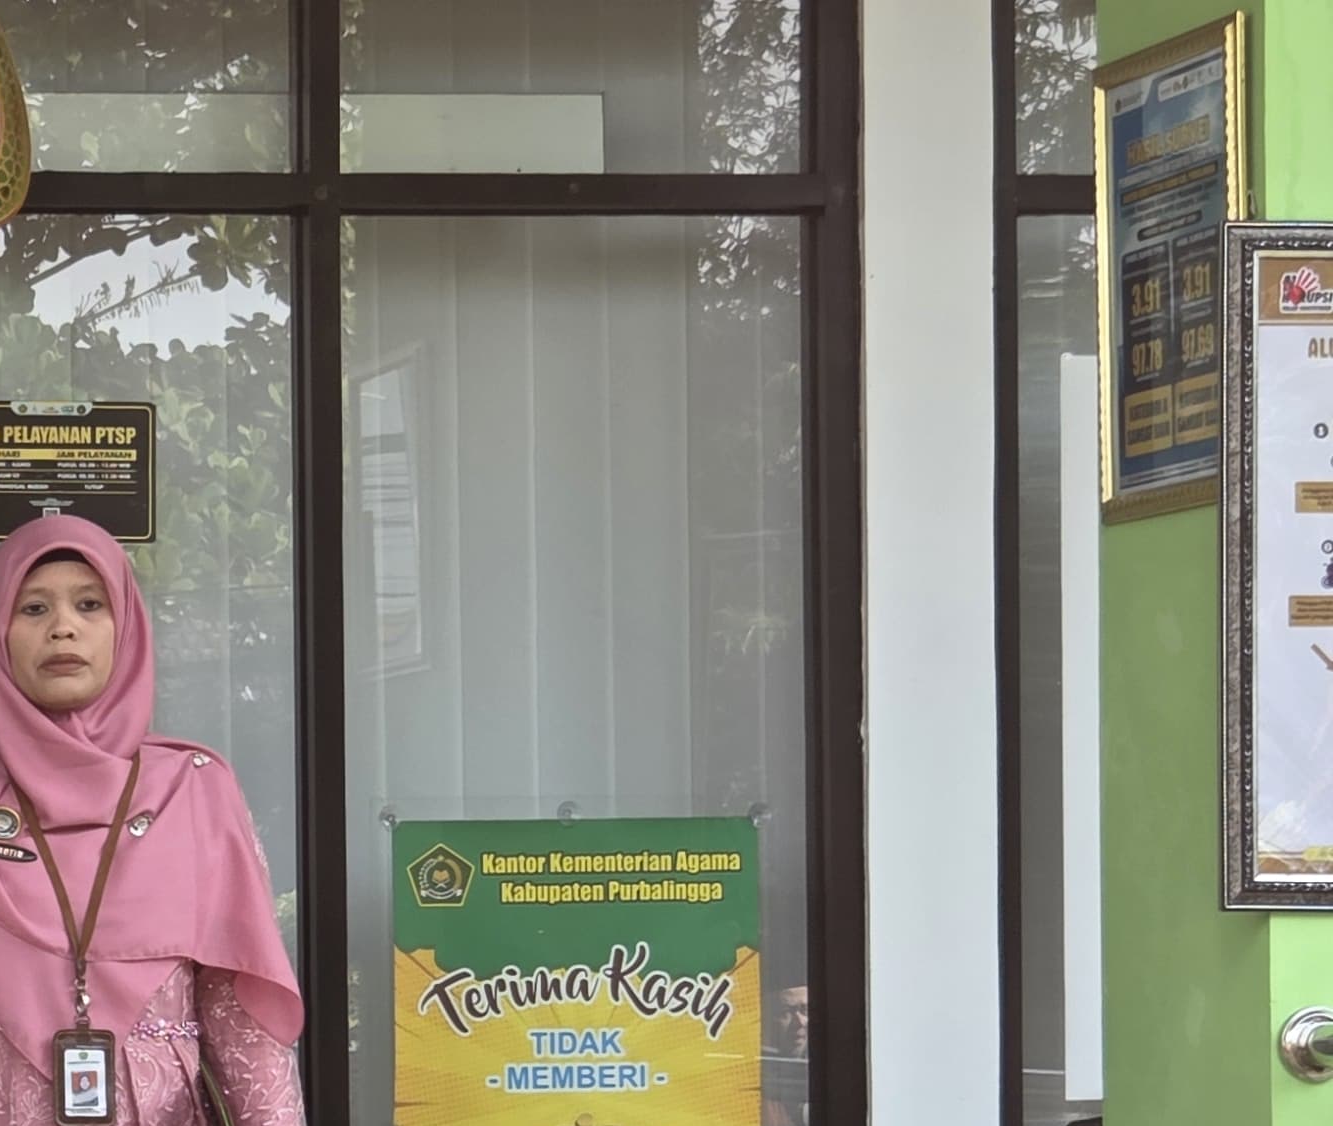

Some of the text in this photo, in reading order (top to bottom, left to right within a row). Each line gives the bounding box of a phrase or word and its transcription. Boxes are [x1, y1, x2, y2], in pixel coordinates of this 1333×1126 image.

[1183, 261, 1211, 299] 3.91
[1132, 279, 1161, 316] 3.91
[3, 426, 91, 444] PELAYANAN
[95, 427, 136, 444] PTSP
[482, 851, 740, 873] Kantor Kementerian Agama
[501, 880, 723, 904] Kabupaten Purbalingga
[420, 944, 730, 1038] Terima Kasih
[530, 1031, 621, 1054] TIDAK
[507, 1065, 645, 1089] MEMBERI
